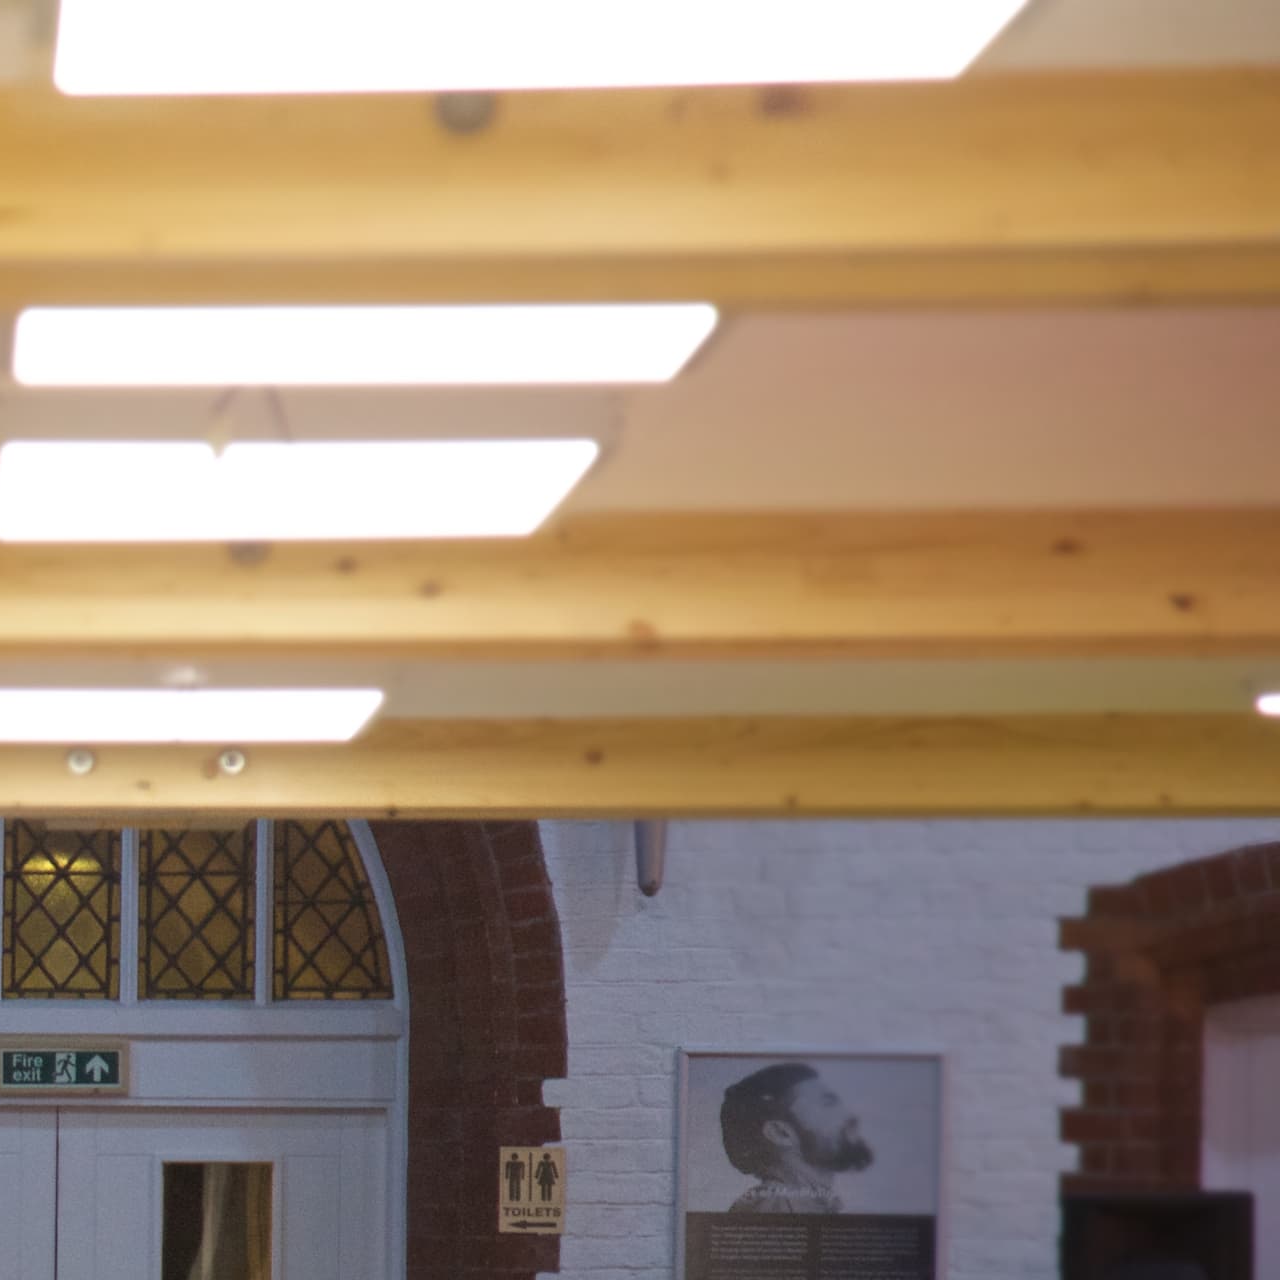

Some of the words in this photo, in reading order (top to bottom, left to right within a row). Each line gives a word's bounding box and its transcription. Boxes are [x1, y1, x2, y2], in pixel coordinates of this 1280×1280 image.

[12, 1054, 43, 1067] Fire
[12, 1068, 41, 1082] exit
[503, 1207, 561, 1217] TOILETS
